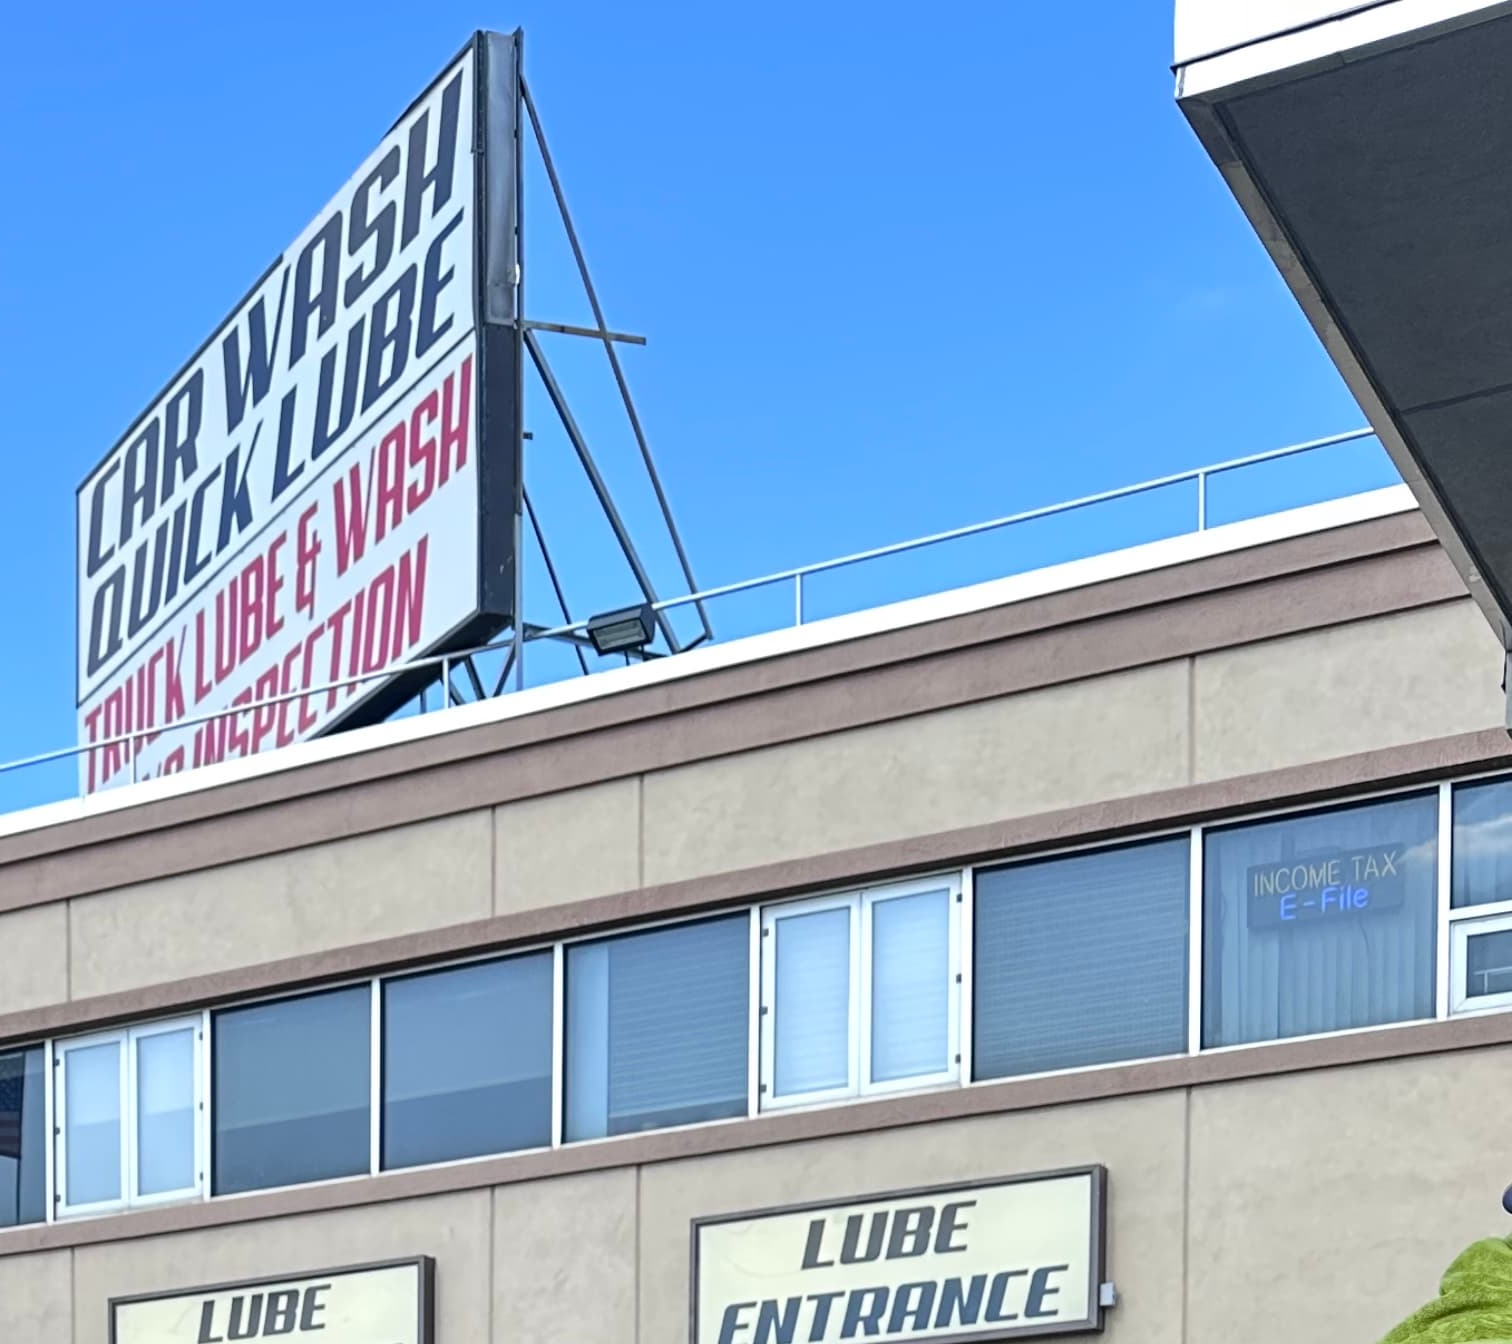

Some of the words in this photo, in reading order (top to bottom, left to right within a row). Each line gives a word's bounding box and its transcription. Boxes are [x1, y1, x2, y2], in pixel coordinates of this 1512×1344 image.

[87, 367, 204, 578] CAR
[223, 67, 465, 436] WASH
[87, 418, 264, 679] QUICK
[271, 206, 465, 503] LUBE
[85, 624, 188, 795] TRUCK
[195, 529, 287, 706] LUBE
[295, 500, 322, 621] &
[333, 352, 473, 578] WASH
[1254, 860, 1341, 897] INCOME
[1351, 850, 1399, 881] TAX
[198, 1284, 332, 1344] LUBE
[801, 1200, 977, 1270] LUBE
